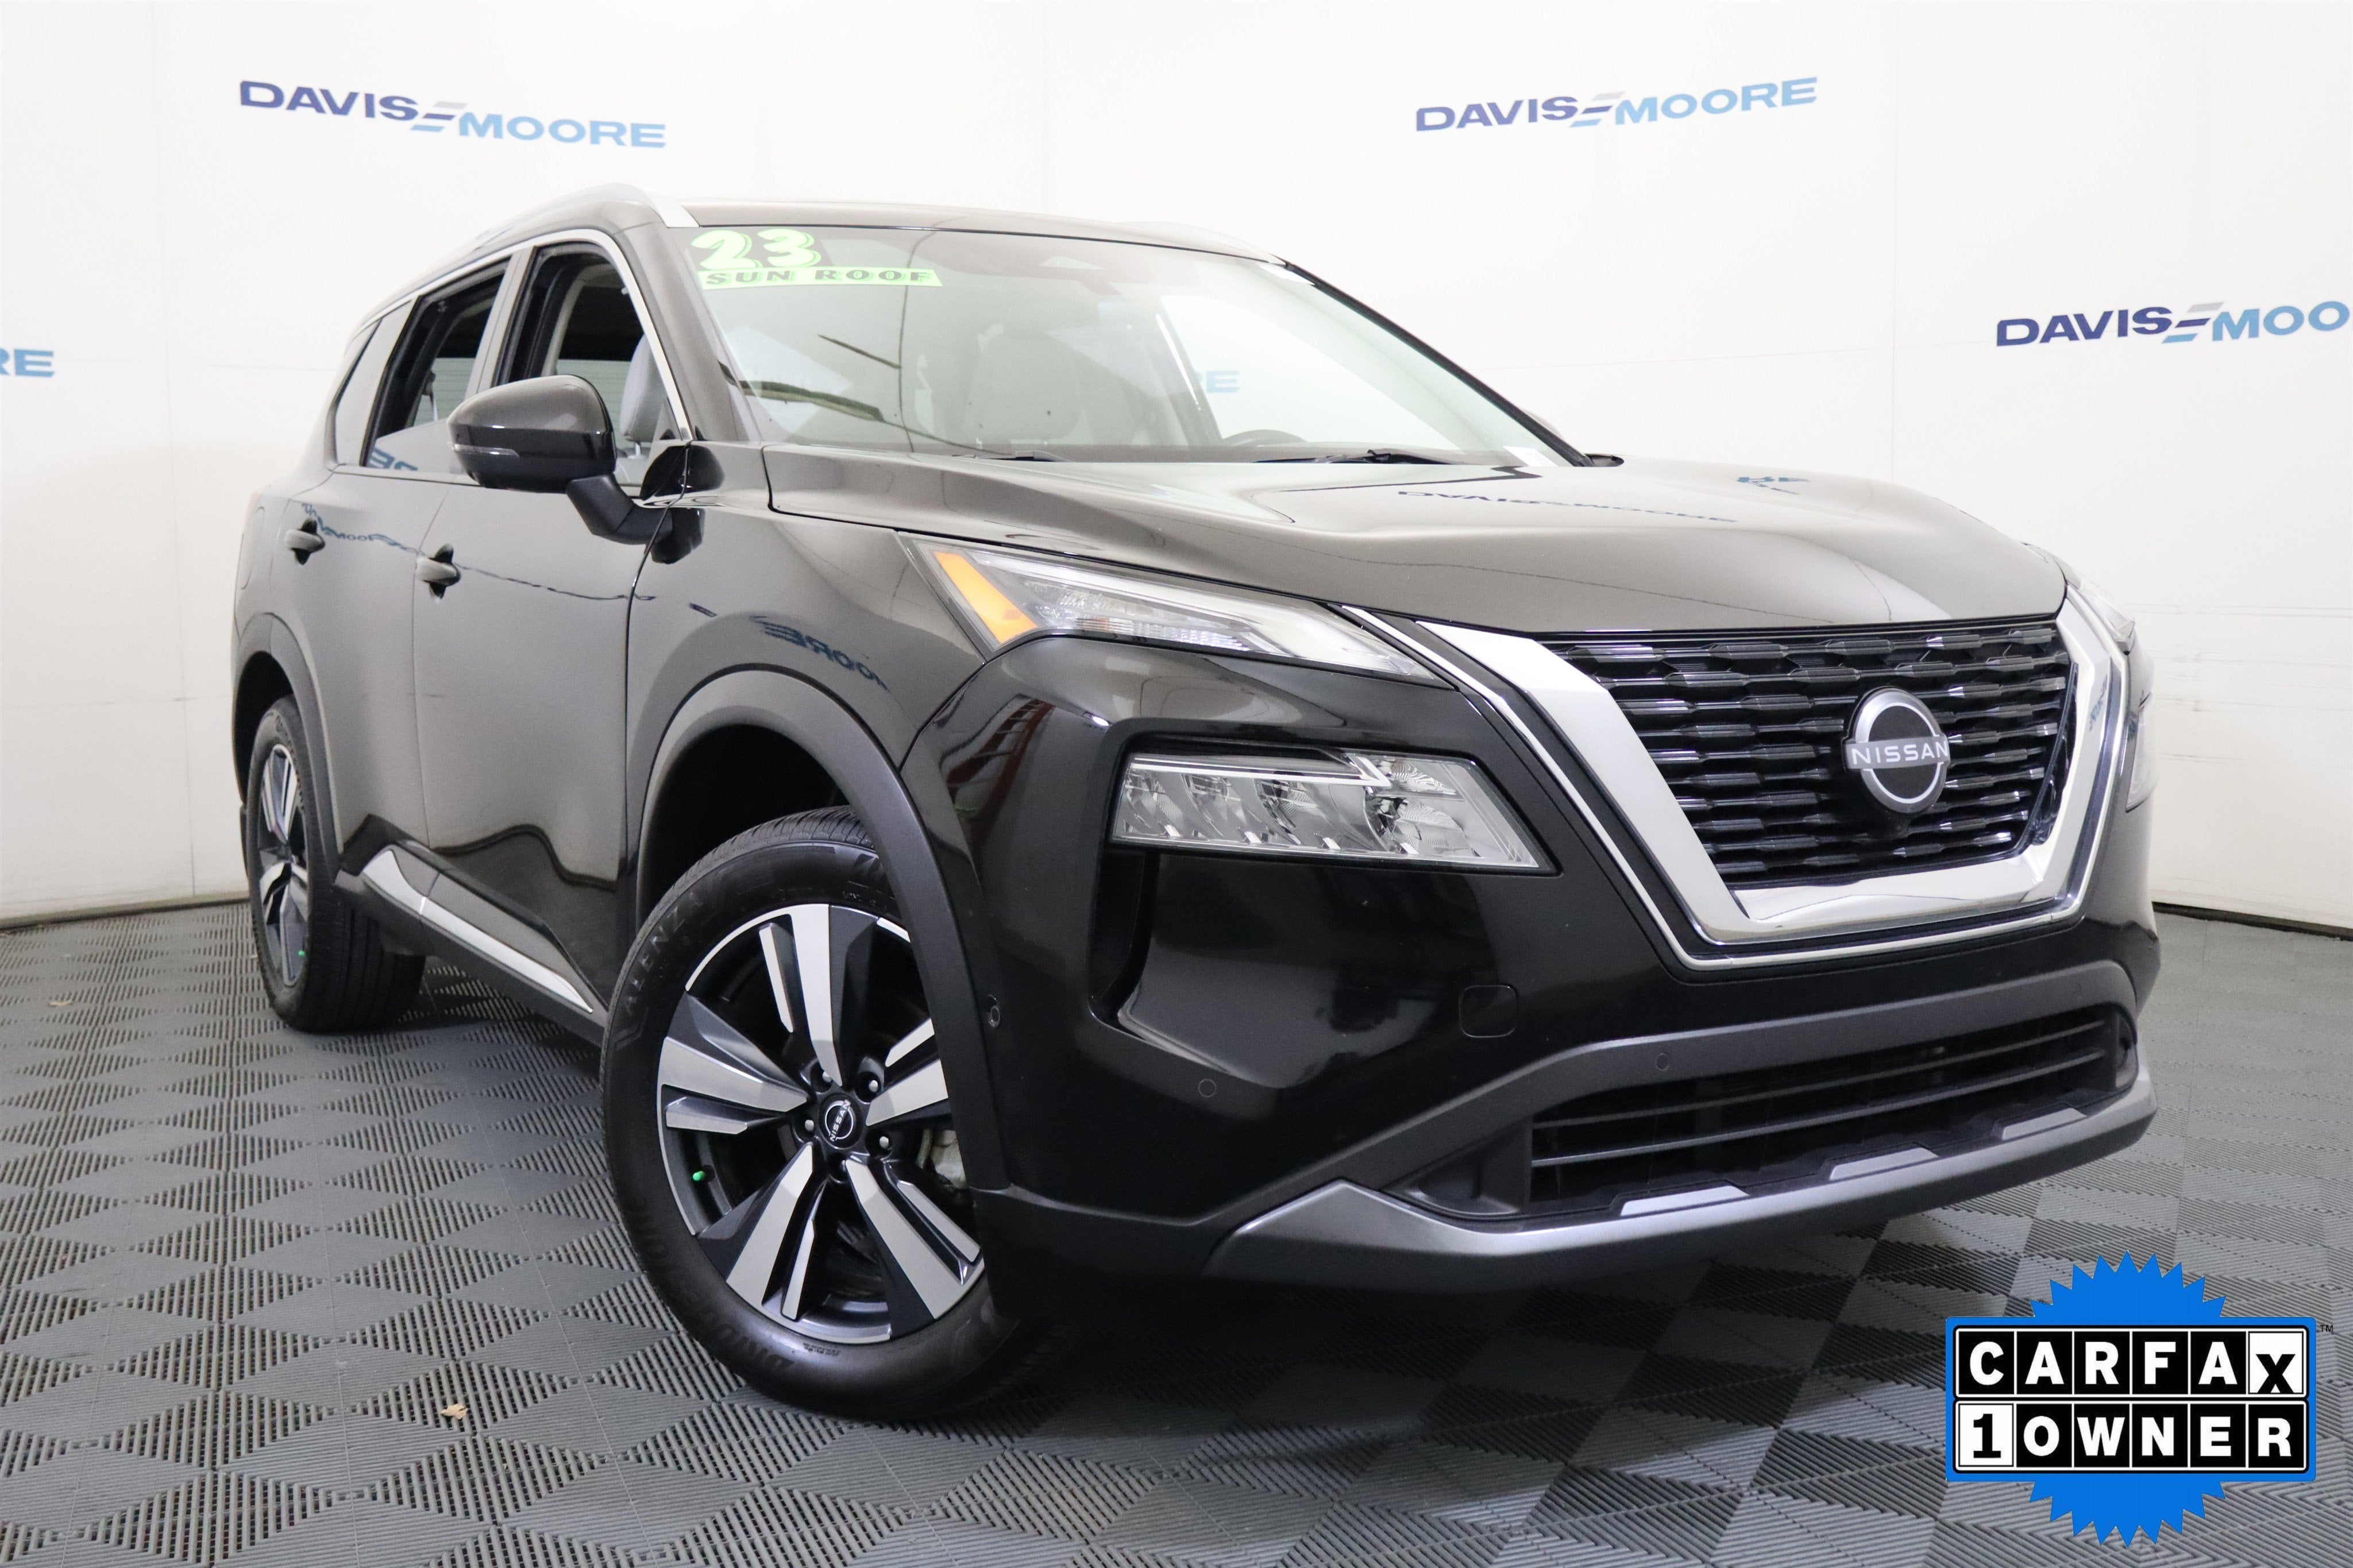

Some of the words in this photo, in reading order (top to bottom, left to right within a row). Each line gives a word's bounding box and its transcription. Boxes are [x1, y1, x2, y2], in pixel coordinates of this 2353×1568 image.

[240, 80, 418, 121] DAVIS
[459, 113, 666, 148] MOORE
[1416, 96, 1579, 132] DAVIS
[1615, 77, 1818, 125] MOORE
[691, 229, 821, 269] 23
[705, 270, 793, 285] SUN
[815, 269, 933, 281] ROOF
[1996, 306, 2173, 346] DAVIS
[0, 347, 55, 378] E
[1851, 741, 1949, 765] NISSAN
[830, 1100, 850, 1142] NISSAN
